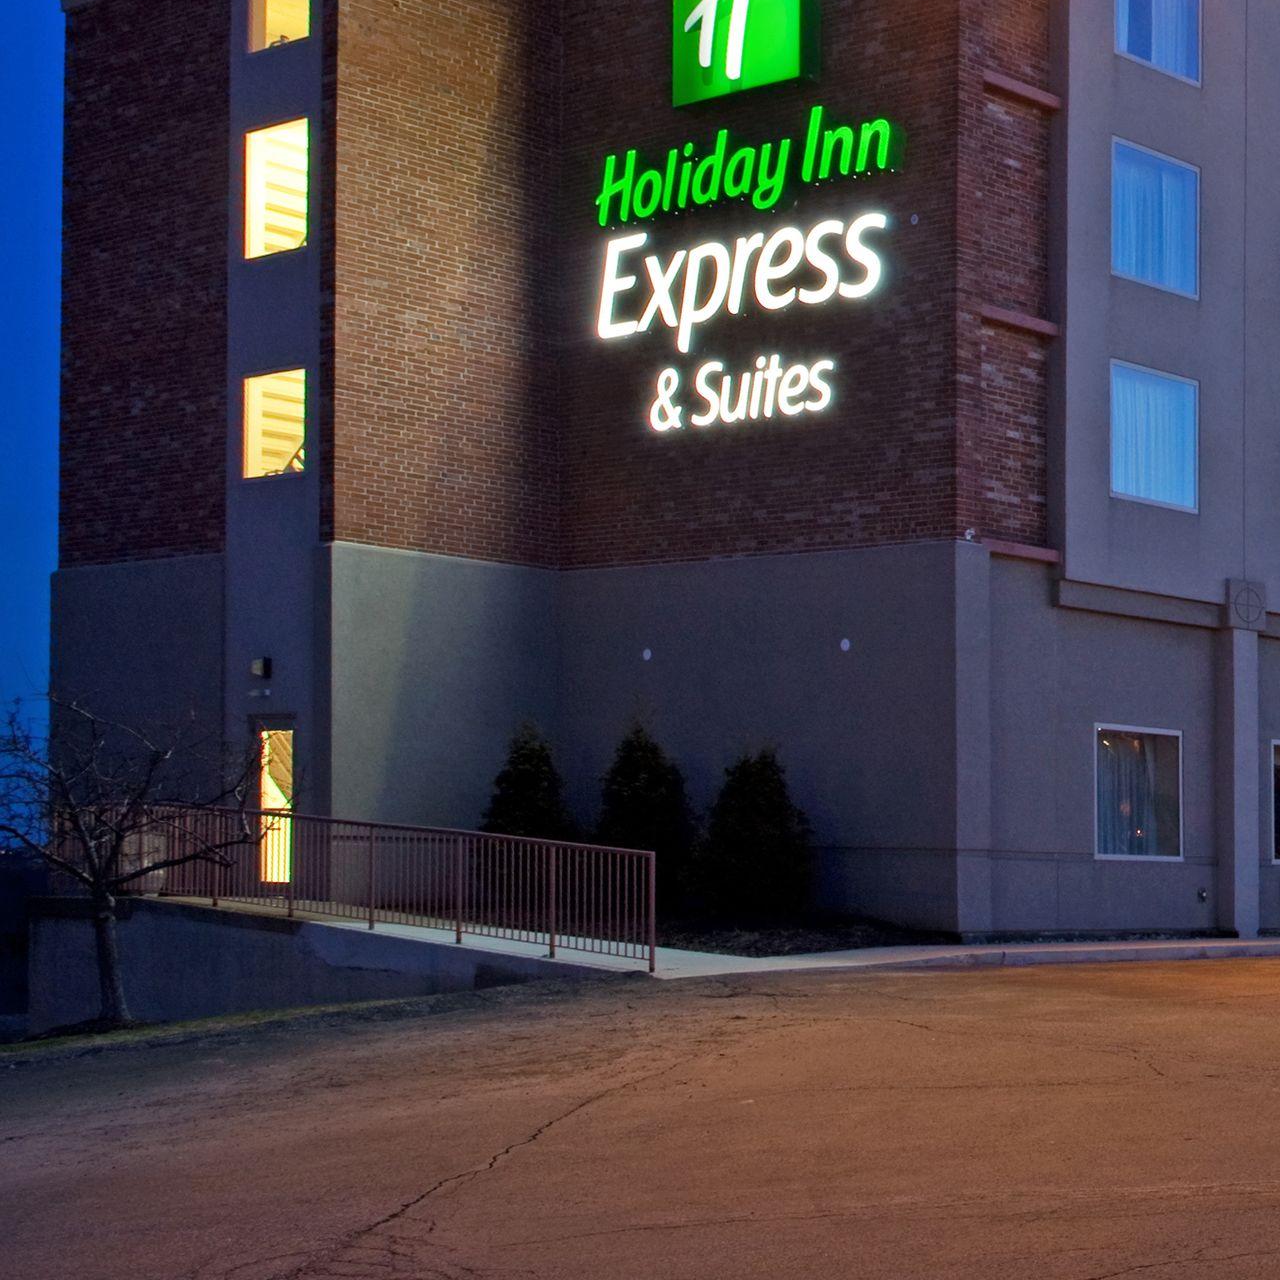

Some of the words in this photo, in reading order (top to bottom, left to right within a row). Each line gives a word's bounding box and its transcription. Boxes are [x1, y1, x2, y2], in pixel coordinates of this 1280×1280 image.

[596, 129, 791, 226] Holiday
[801, 105, 890, 183] Inn
[596, 213, 887, 353] Express
[649, 367, 683, 431] &
[690, 354, 834, 427] Suites
